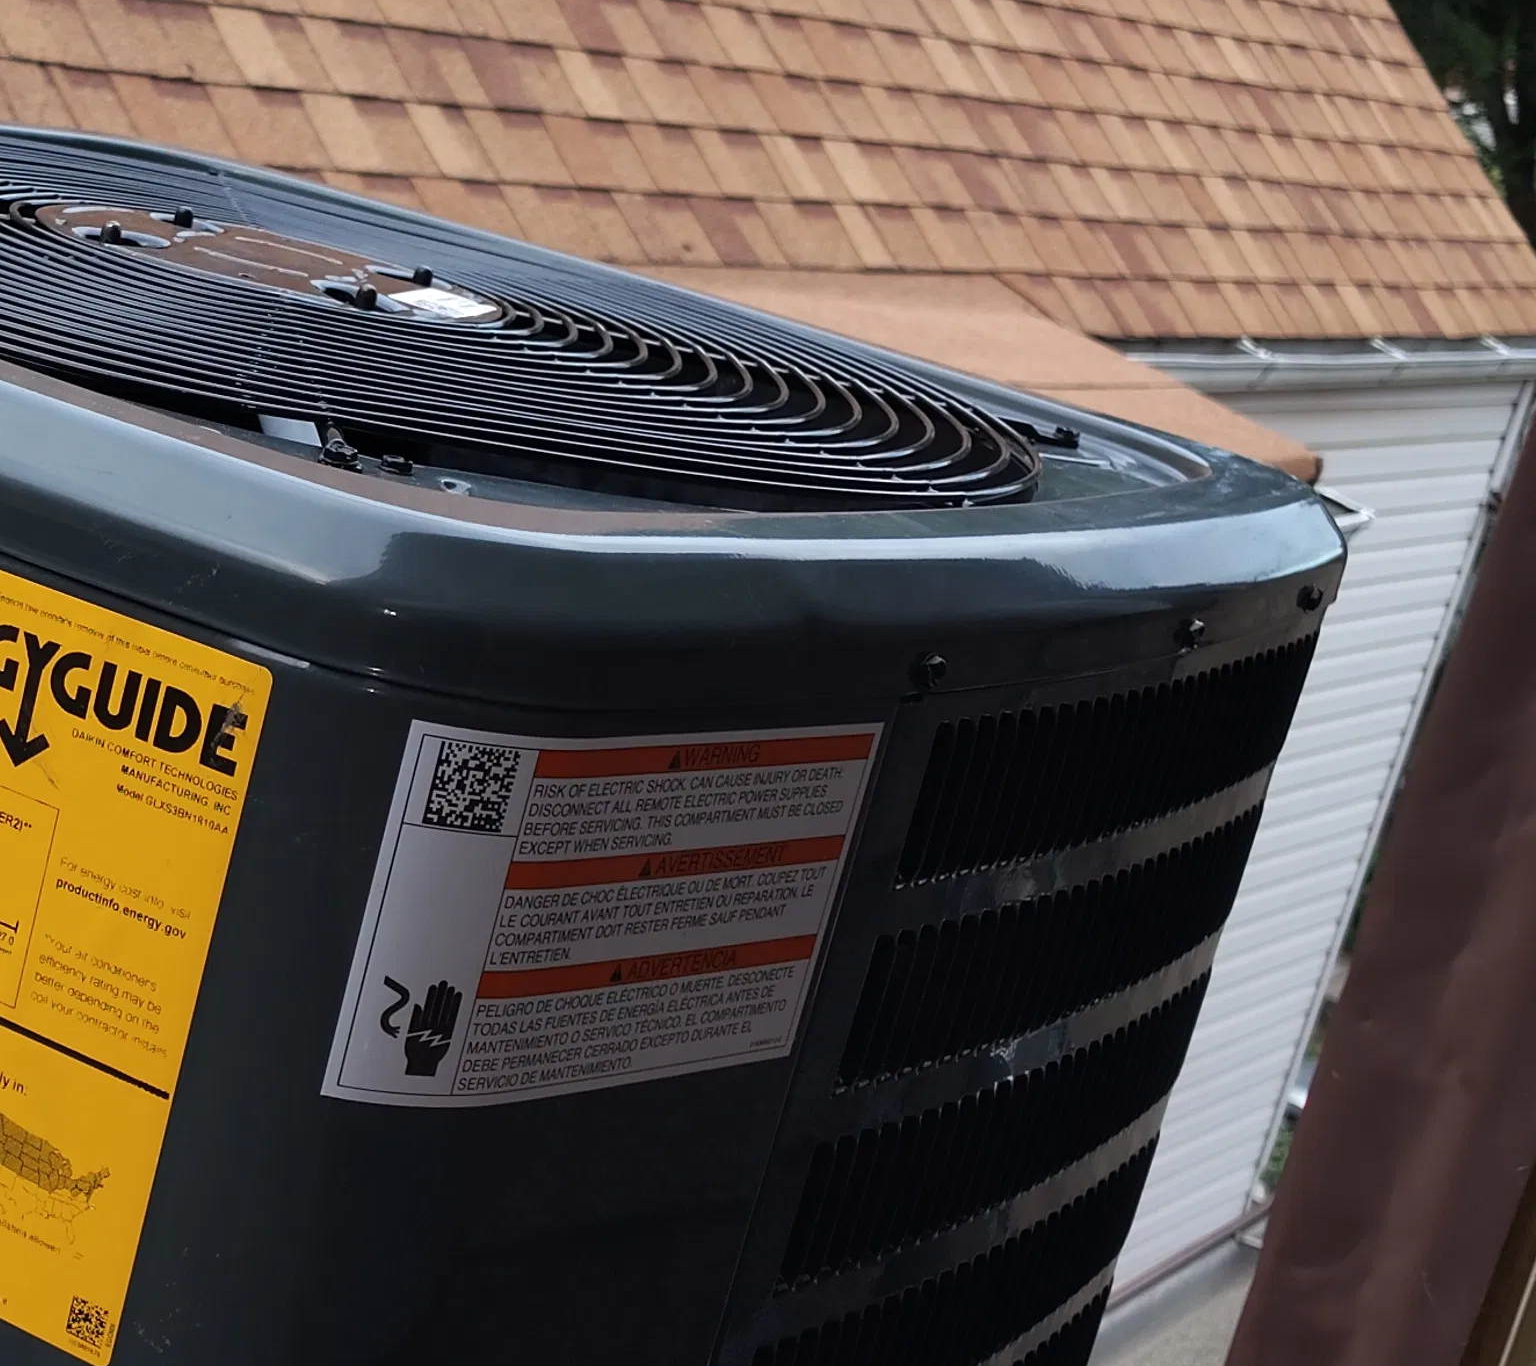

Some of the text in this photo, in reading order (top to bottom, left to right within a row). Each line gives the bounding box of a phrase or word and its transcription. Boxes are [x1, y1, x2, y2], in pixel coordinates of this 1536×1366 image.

[106, 741, 157, 769] COMFORT
[159, 761, 239, 801] TECHNOLOGIES
[680, 742, 762, 770] WARNING
[532, 783, 568, 800] RISK
[567, 783, 588, 799] OF
[587, 779, 645, 798] ELECTRIC
[689, 775, 715, 791] CAN
[714, 772, 754, 789] CAUSE
[752, 770, 792, 787] INJURY
[791, 768, 808, 783] OR
[522, 820, 579, 837] BEFORE
[647, 814, 673, 830] THIS
[673, 807, 758, 828] COMPARTMENT
[756, 804, 789, 820] MUST
[786, 803, 804, 818] BE
[802, 799, 844, 816] CLOSED
[527, 784, 829, 819] DISCONNECT ALL REMOTE ELECTRIC POWER SUPPLIES
[654, 840, 792, 873] AVERTISSEMENT
[55, 878, 187, 940] productinfo.energy.gov
[623, 948, 737, 981] ADVERTENCIA
